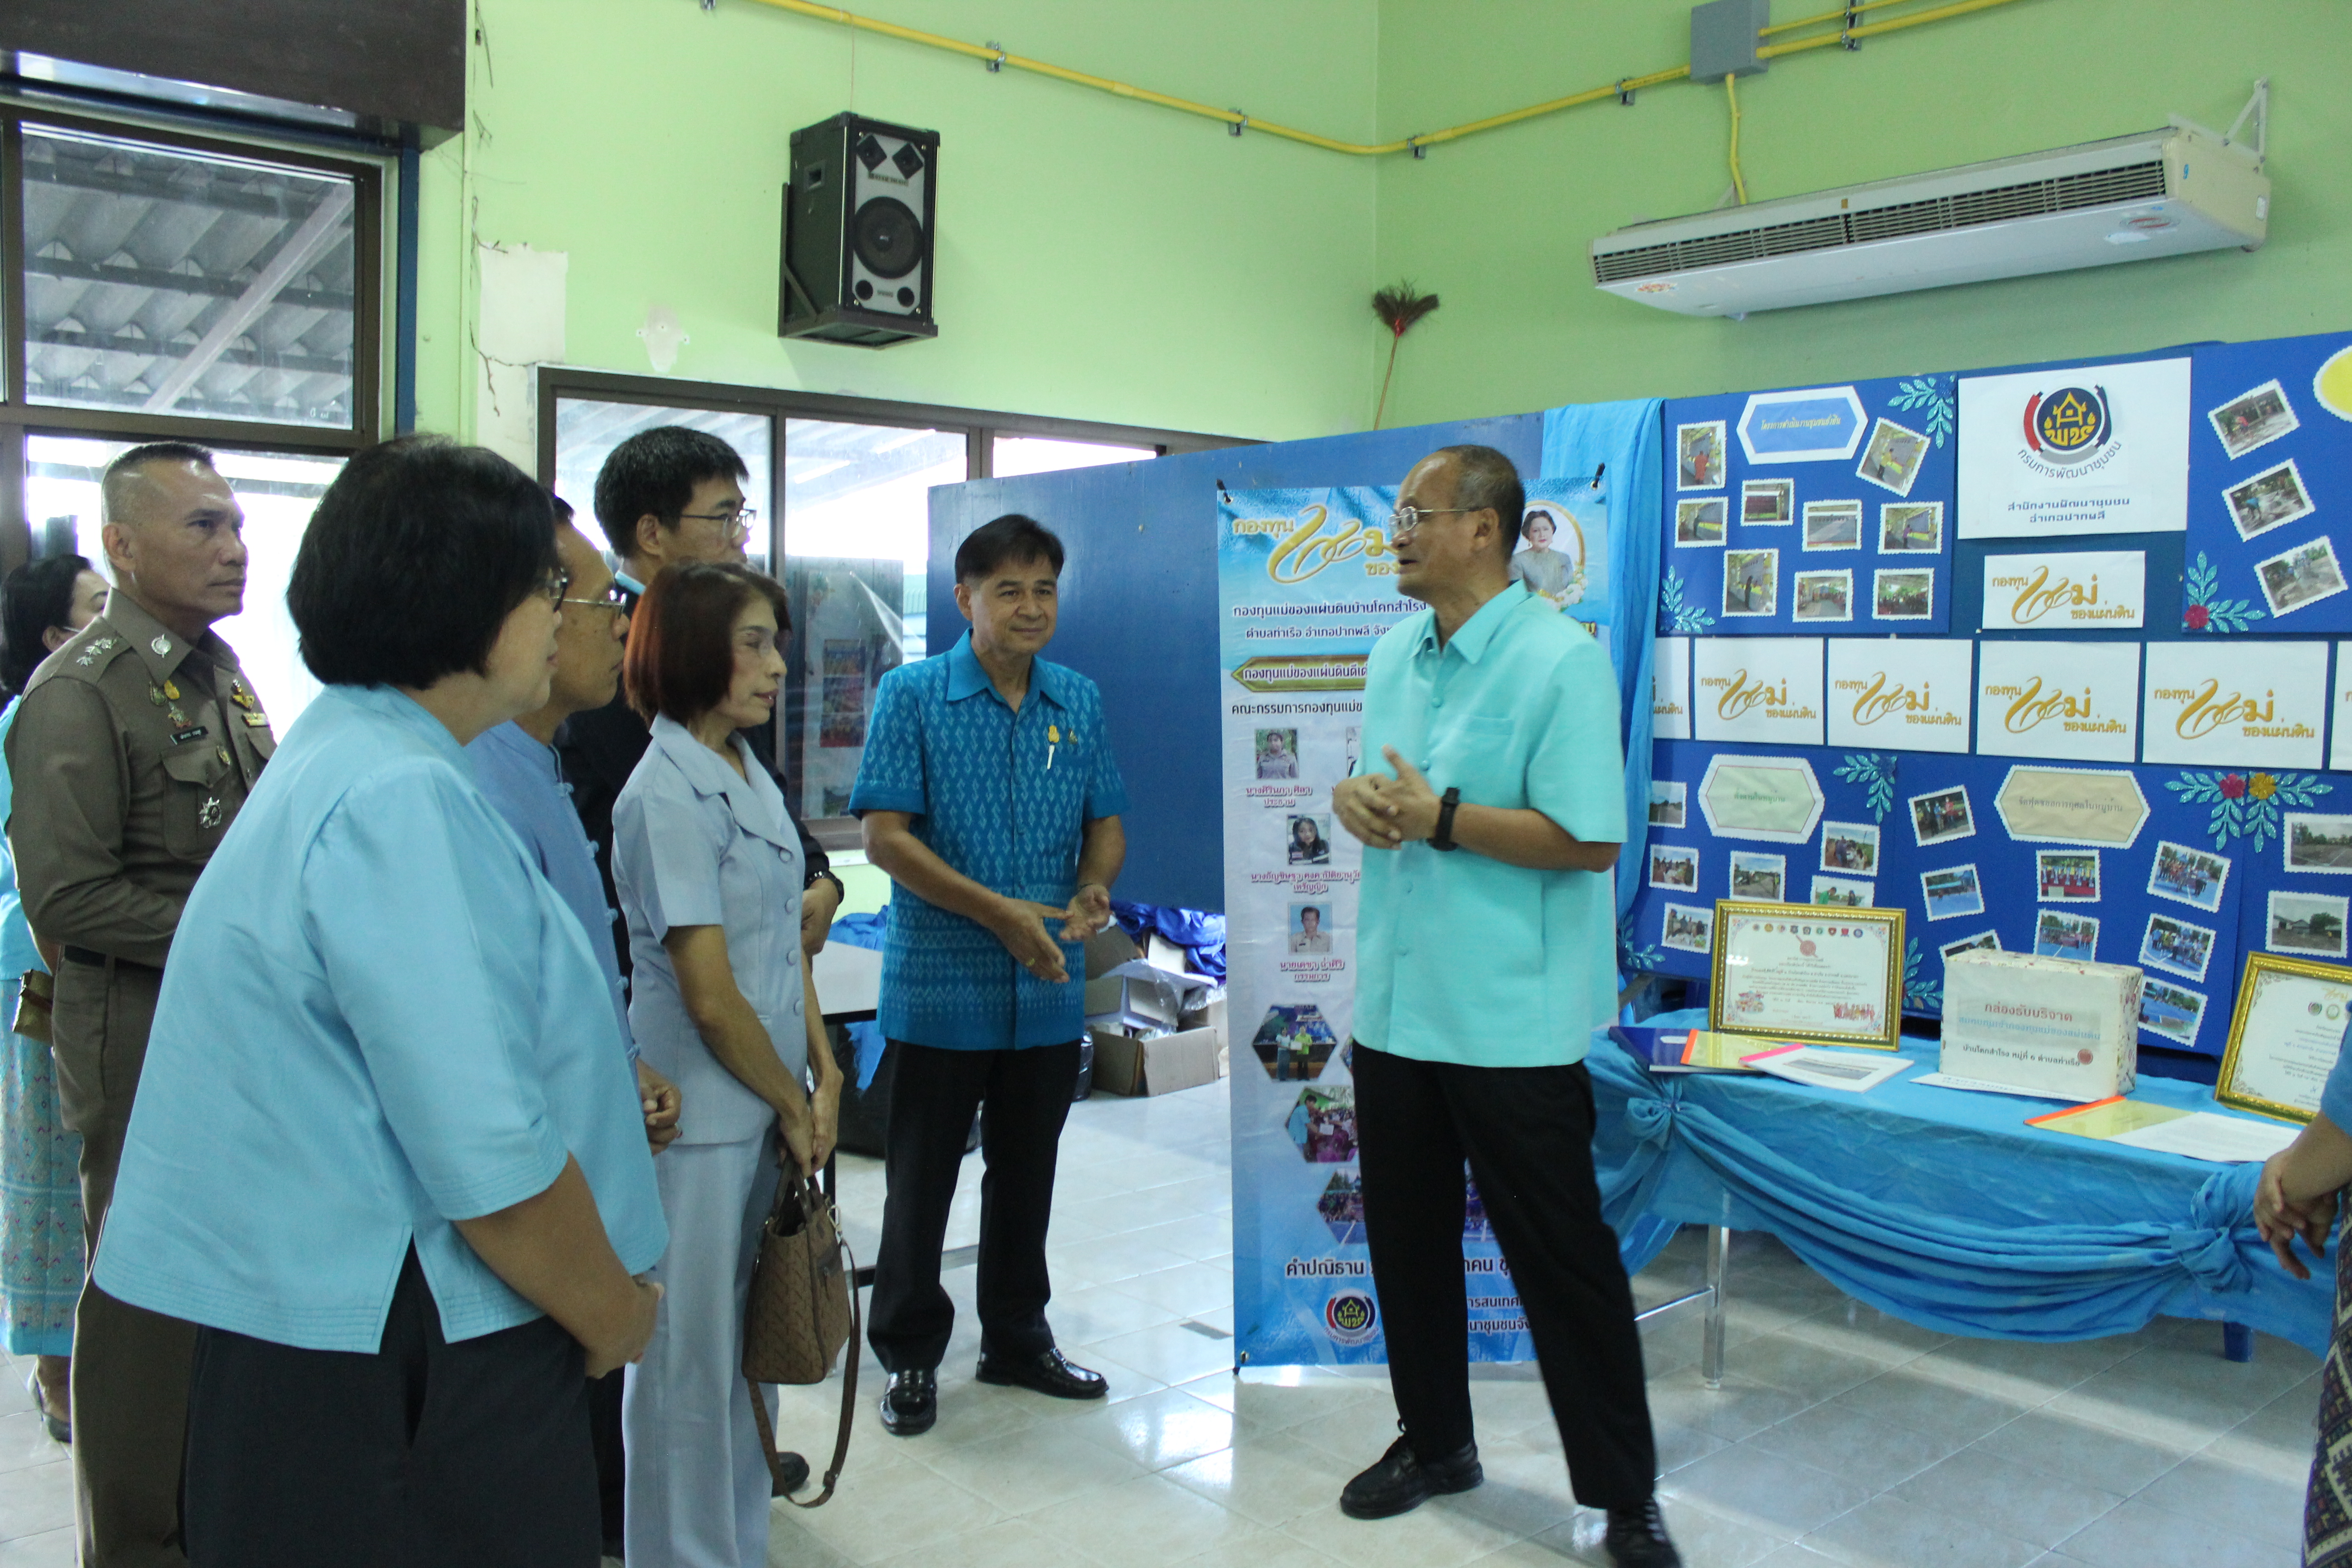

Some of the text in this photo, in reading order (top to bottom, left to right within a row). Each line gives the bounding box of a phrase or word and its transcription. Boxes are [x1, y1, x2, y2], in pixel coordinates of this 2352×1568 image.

[2018, 440, 2122, 479] กรมการพัฒนาชุมชน
[2008, 497, 2130, 512] สำนักงานพัฒนาชุมชน
[2030, 510, 2106, 523] อำเภอปากพลี
[1233, 519, 1294, 538] กองทุน
[1992, 577, 2029, 590] กองทุน
[1234, 601, 1426, 618] กองทุนแม่ของแผ่นดินบ้านโคกสำโรง
[2071, 600, 2135, 620] ของแผ่นดิน
[1246, 627, 1302, 639] ตำบลท่าเรือ
[1305, 626, 1369, 638] อำเภอปากพลี
[1701, 678, 1730, 691] กองทุน
[1835, 680, 1868, 693] กองทุน
[1985, 685, 2022, 700] กองทุน
[2154, 688, 2195, 702] กองทุน
[1766, 702, 1816, 719] ของแผ่นดิน
[1906, 707, 1961, 726] ของแผ่นดิน
[2063, 715, 2126, 734] ของแผ่นดิน
[2242, 718, 2314, 739] ของแผ่นดิน
[1264, 798, 1294, 807] ประธาน
[1984, 1001, 2073, 1022] กล่องรับบริจาค
[1287, 1259, 1364, 1276] คำปณิธาน
